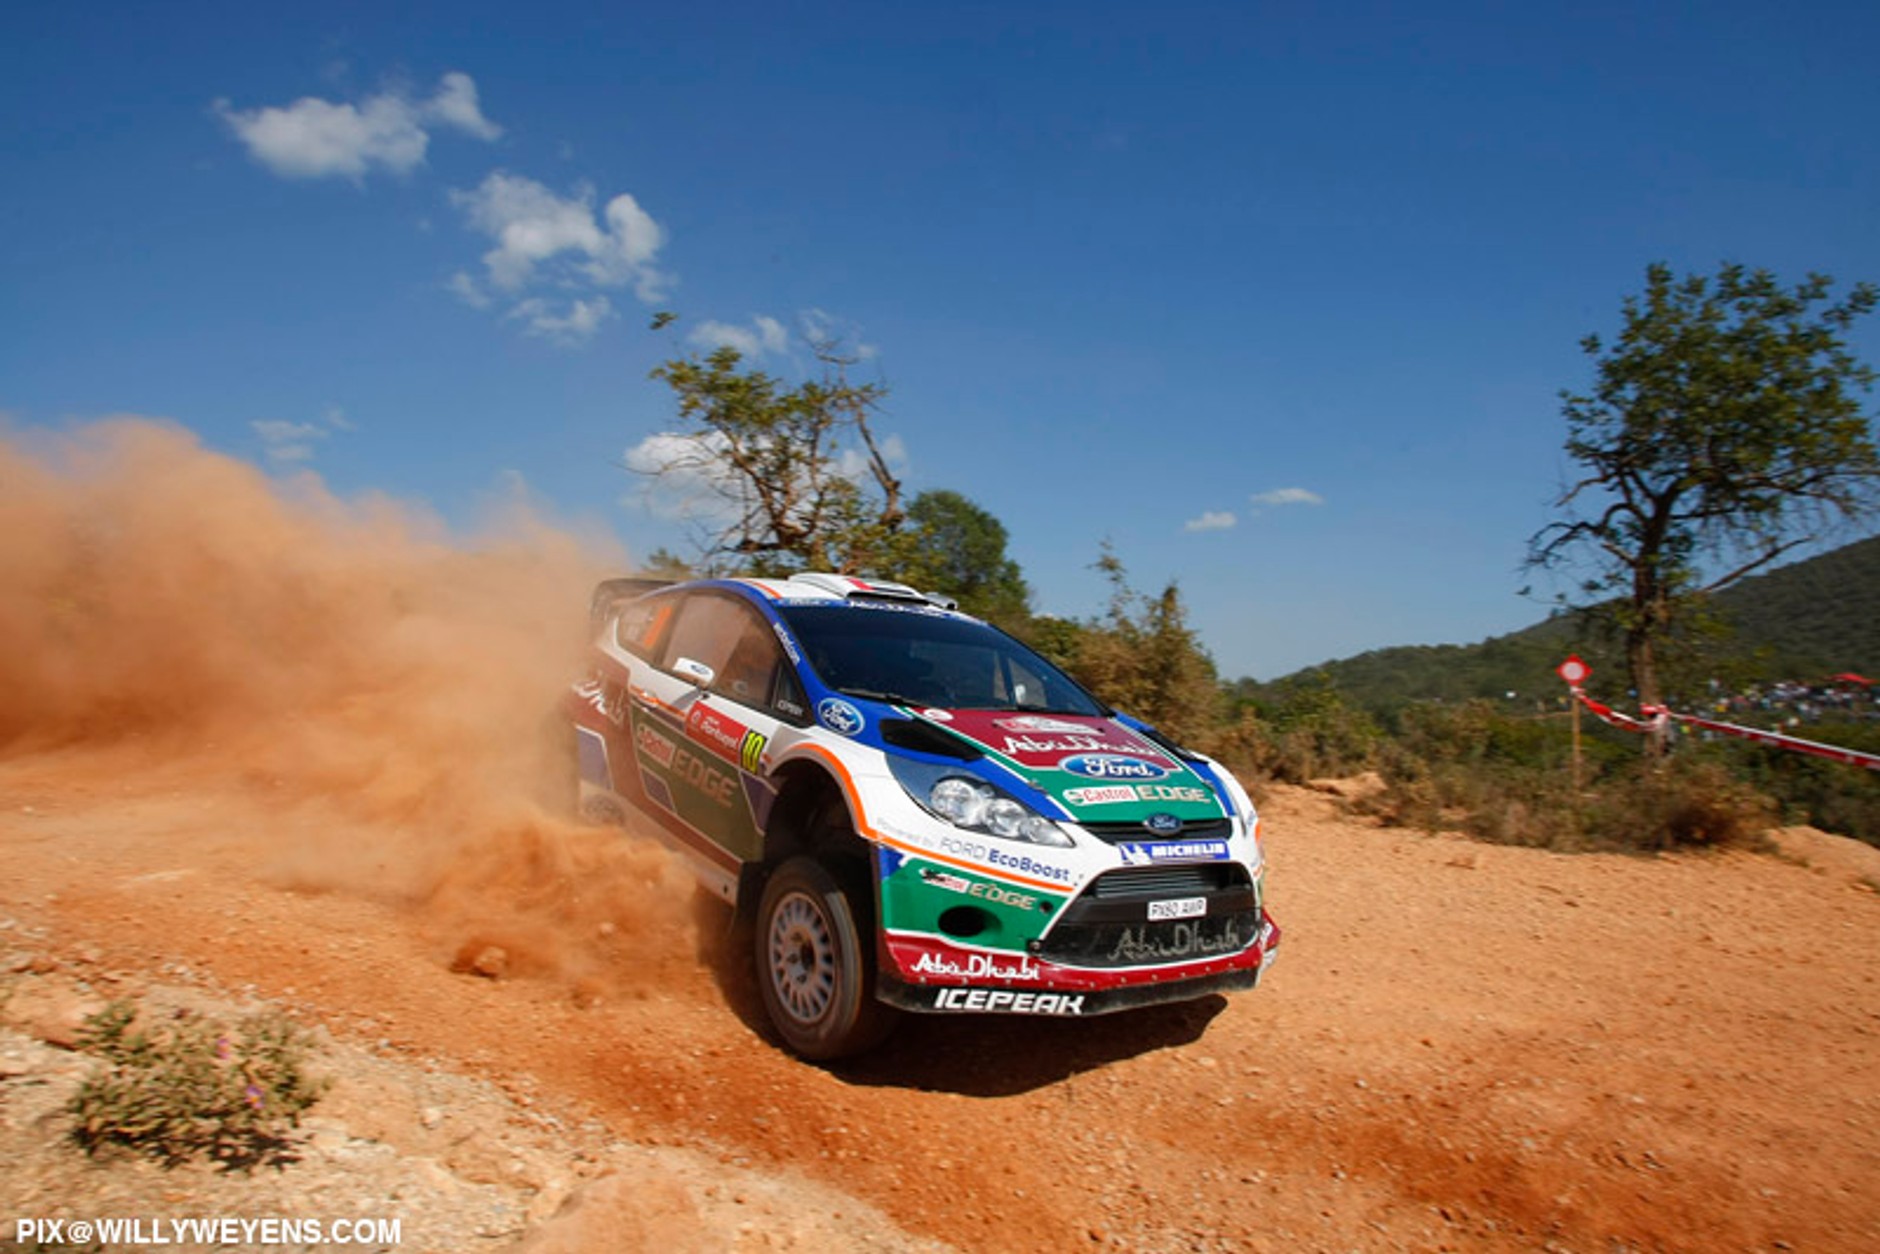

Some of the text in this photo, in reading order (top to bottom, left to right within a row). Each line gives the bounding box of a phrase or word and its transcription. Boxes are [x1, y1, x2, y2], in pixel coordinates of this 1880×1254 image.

[823, 703, 857, 731] Ford
[672, 748, 738, 809] EDGE
[1083, 758, 1155, 777] Ford
[1083, 785, 1211, 804] Castrol EDGE
[1152, 815, 1177, 829] Ford
[940, 836, 985, 861] FORD
[988, 848, 1070, 882] EcoBoost
[1151, 842, 1225, 857] MICHELIN
[969, 882, 1038, 910] EDGE
[934, 987, 1085, 1014] ICEPEAK
